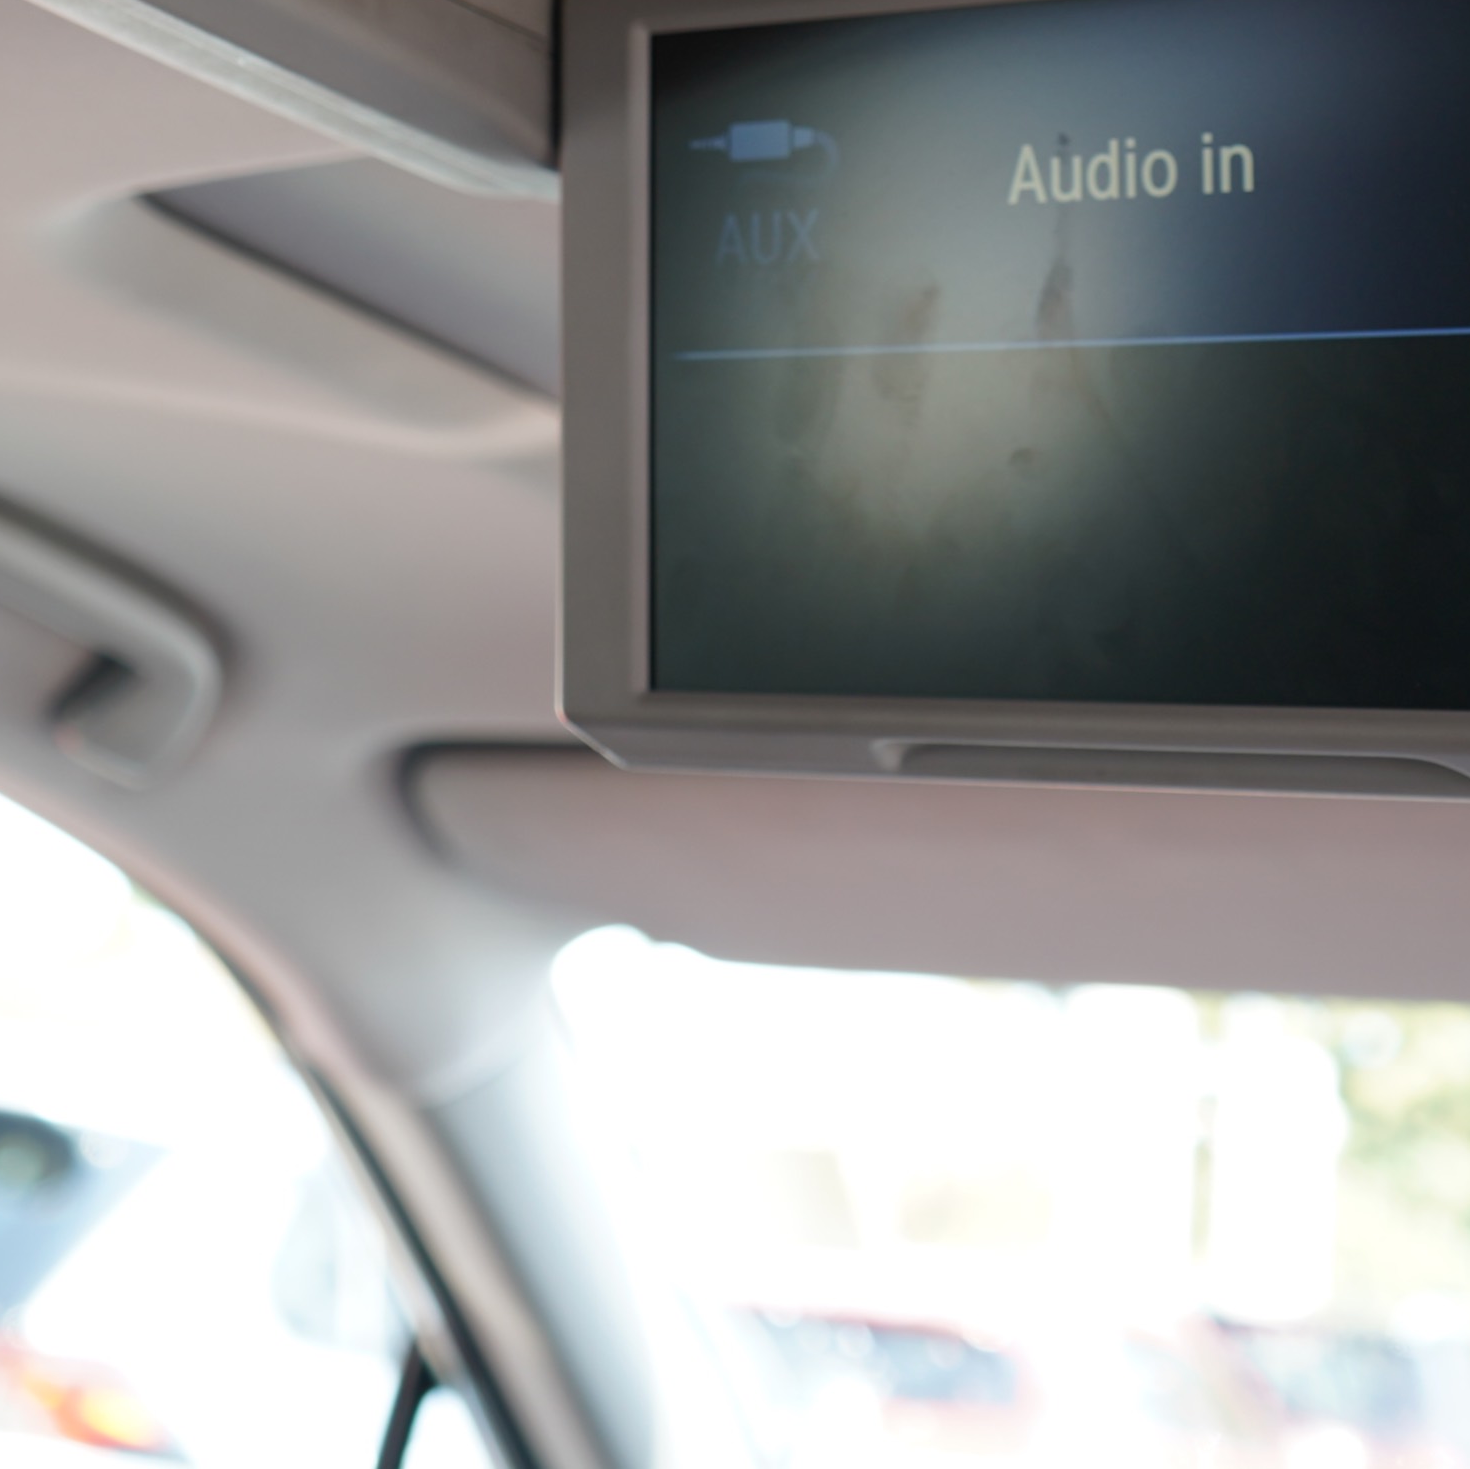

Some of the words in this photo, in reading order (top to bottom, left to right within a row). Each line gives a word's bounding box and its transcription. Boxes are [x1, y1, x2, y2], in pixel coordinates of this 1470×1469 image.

[1007, 136, 1179, 206] Audio
[1201, 132, 1256, 196] in
[715, 208, 822, 267] AUX
